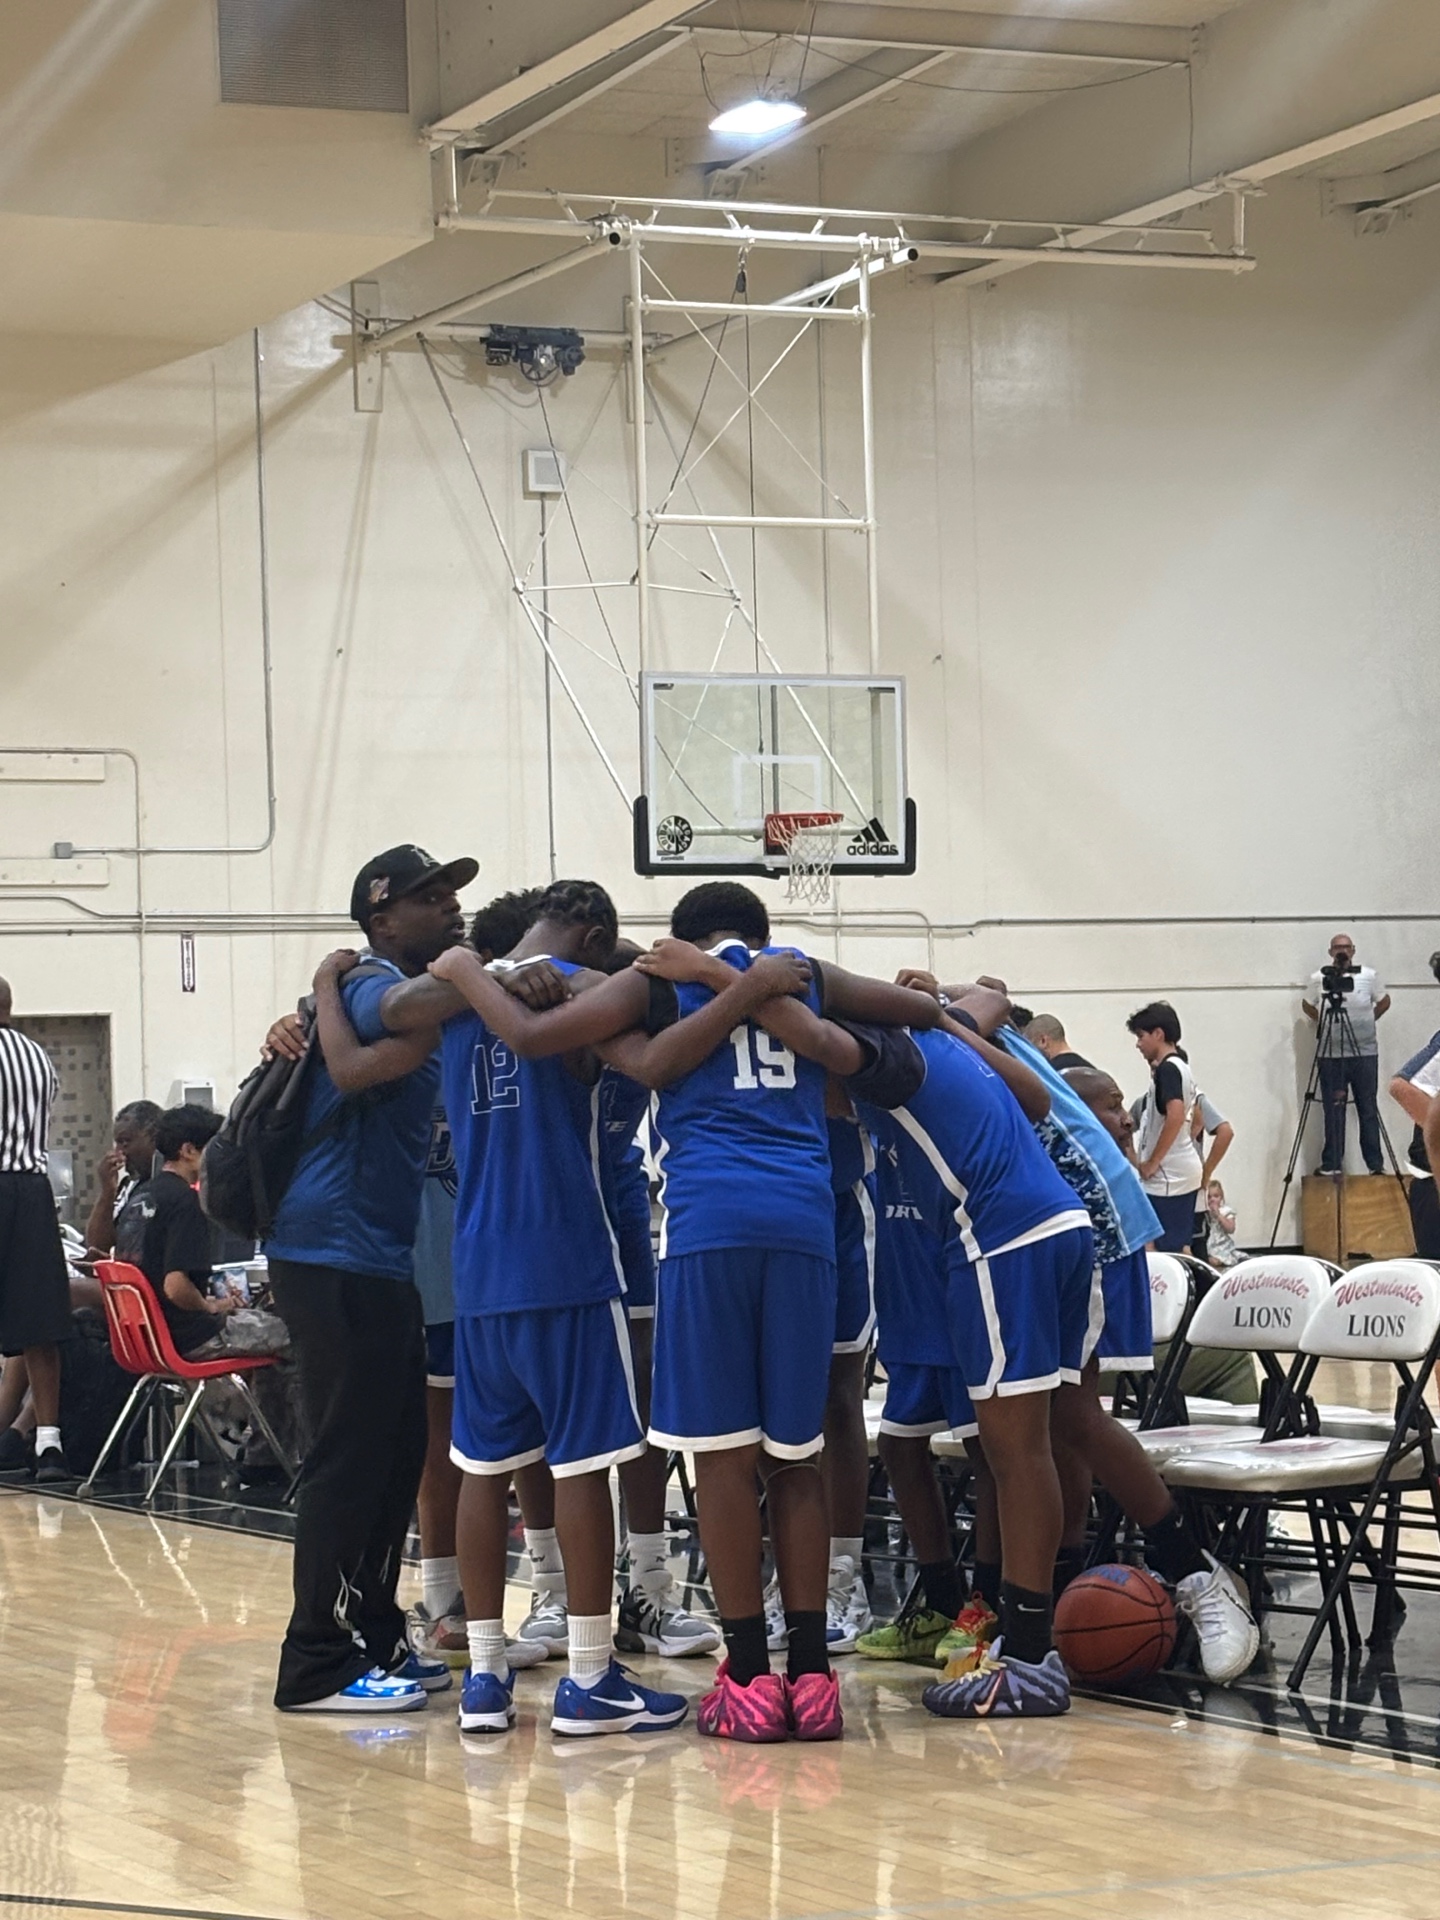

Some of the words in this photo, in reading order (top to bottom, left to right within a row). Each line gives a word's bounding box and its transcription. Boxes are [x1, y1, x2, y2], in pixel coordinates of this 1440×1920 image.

[846, 841, 899, 856] adidas
[470, 1039, 520, 1115] 12
[1221, 1272, 1310, 1300] Westminster
[1335, 1279, 1424, 1308] Westminster
[1233, 1305, 1293, 1329] LIONS
[1346, 1313, 1406, 1338] LIONS
